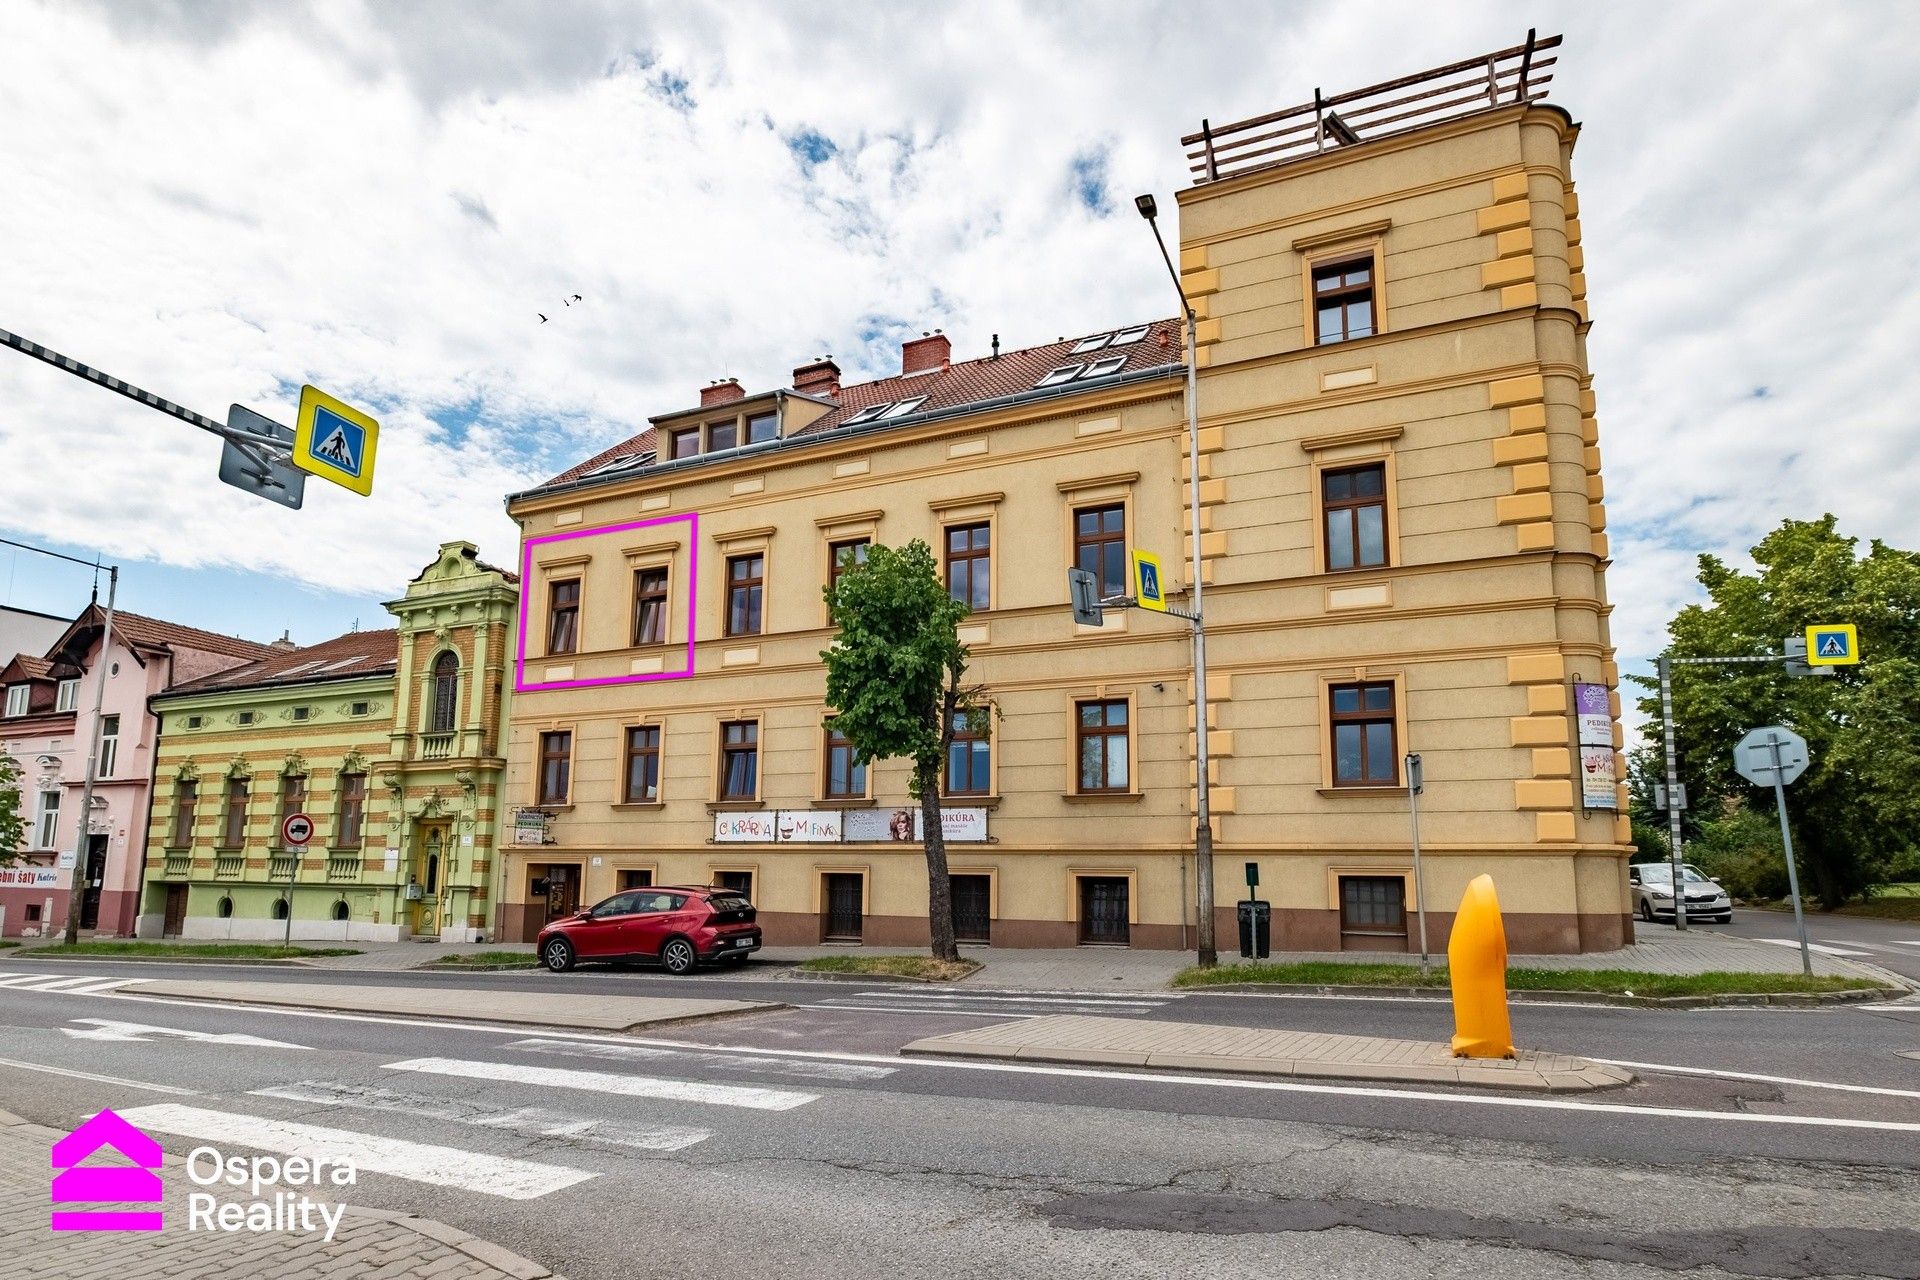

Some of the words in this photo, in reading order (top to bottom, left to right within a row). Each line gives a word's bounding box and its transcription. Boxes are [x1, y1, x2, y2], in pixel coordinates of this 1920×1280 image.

[940, 812, 975, 822] DIKÚRA
[719, 816, 772, 838] CKRÁRNA
[17, 870, 36, 885] šaty
